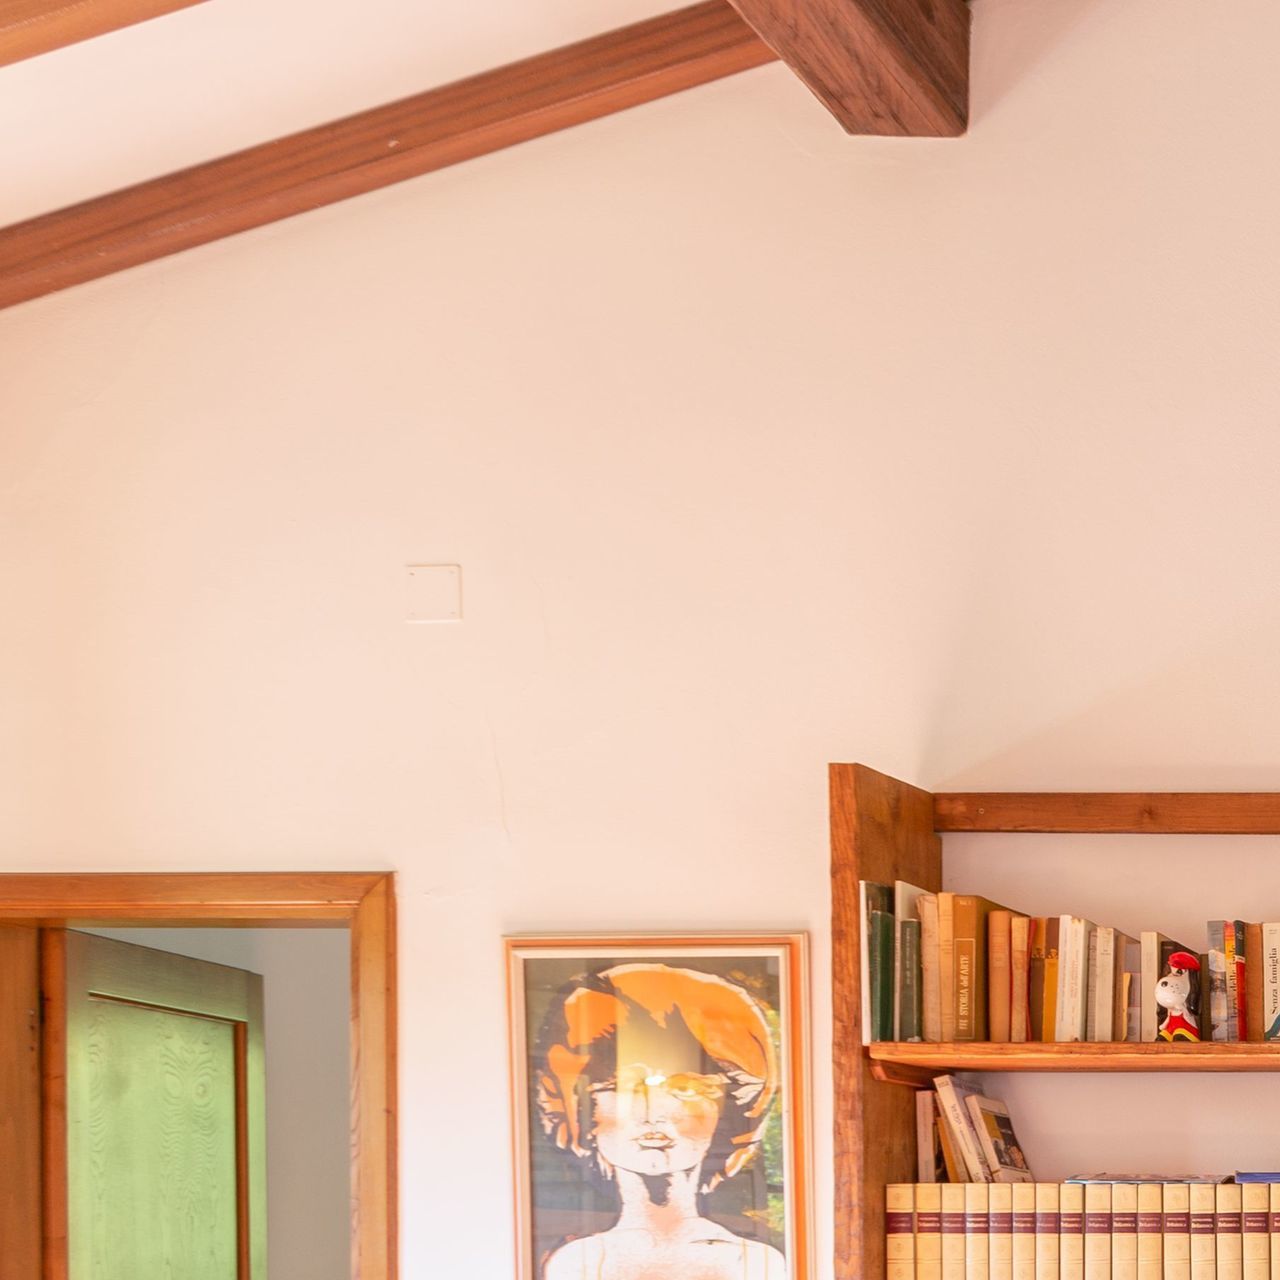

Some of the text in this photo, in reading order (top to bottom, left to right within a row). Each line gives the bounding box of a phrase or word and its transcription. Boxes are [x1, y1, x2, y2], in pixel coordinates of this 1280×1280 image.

[959, 988, 969, 1016] STORIA
[1269, 947, 1279, 1014] Senza famiglia
